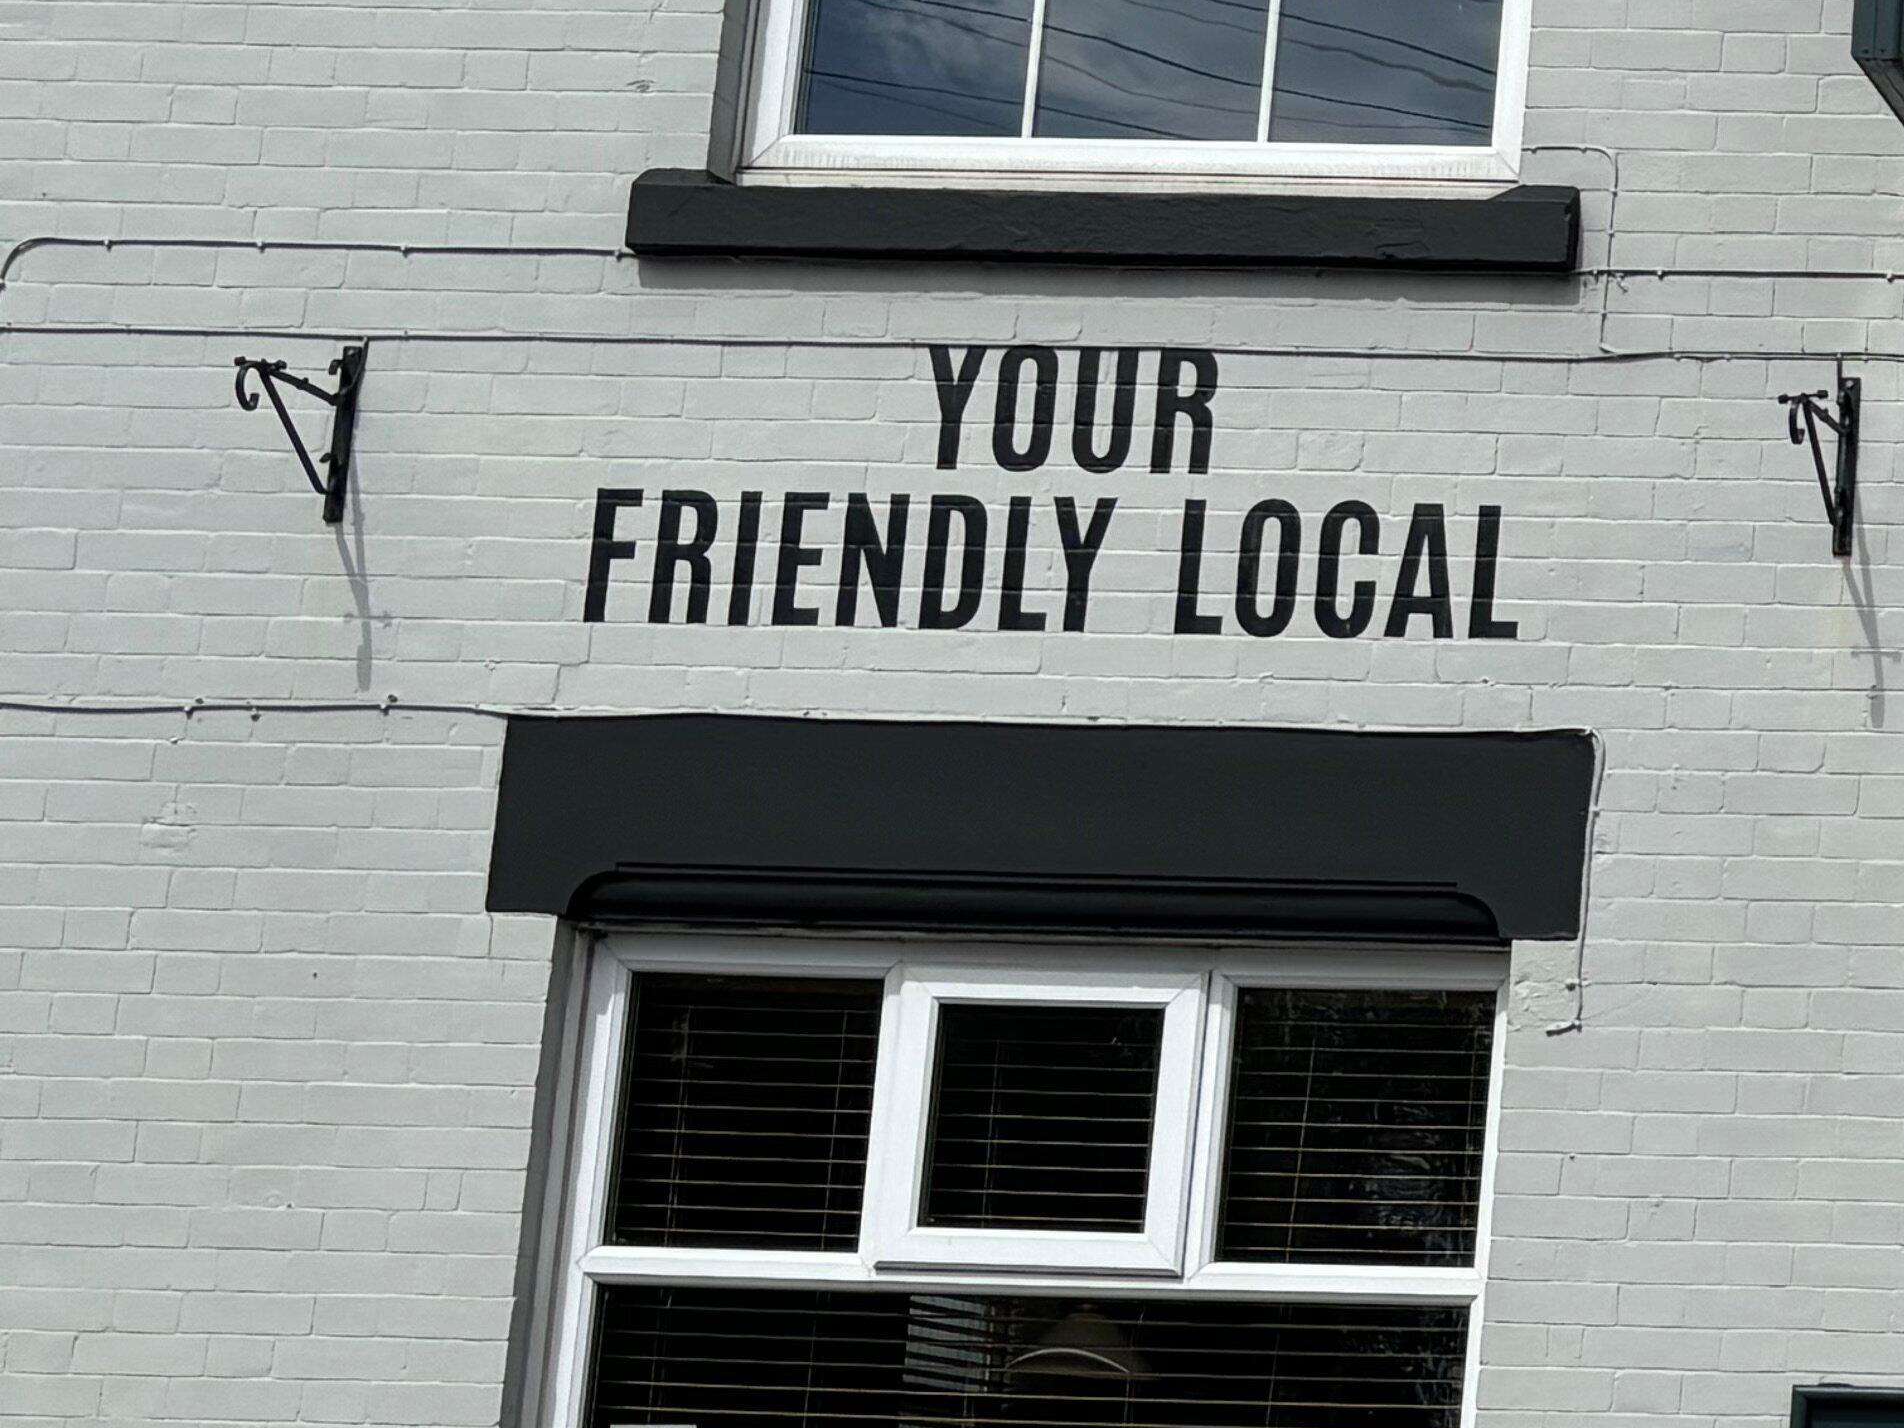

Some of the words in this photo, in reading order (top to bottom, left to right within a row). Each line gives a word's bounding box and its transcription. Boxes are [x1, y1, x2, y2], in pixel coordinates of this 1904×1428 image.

[927, 345, 1219, 475] YOUR
[583, 487, 1118, 634] FRIENDLY
[1173, 498, 1520, 640] LOCAL
